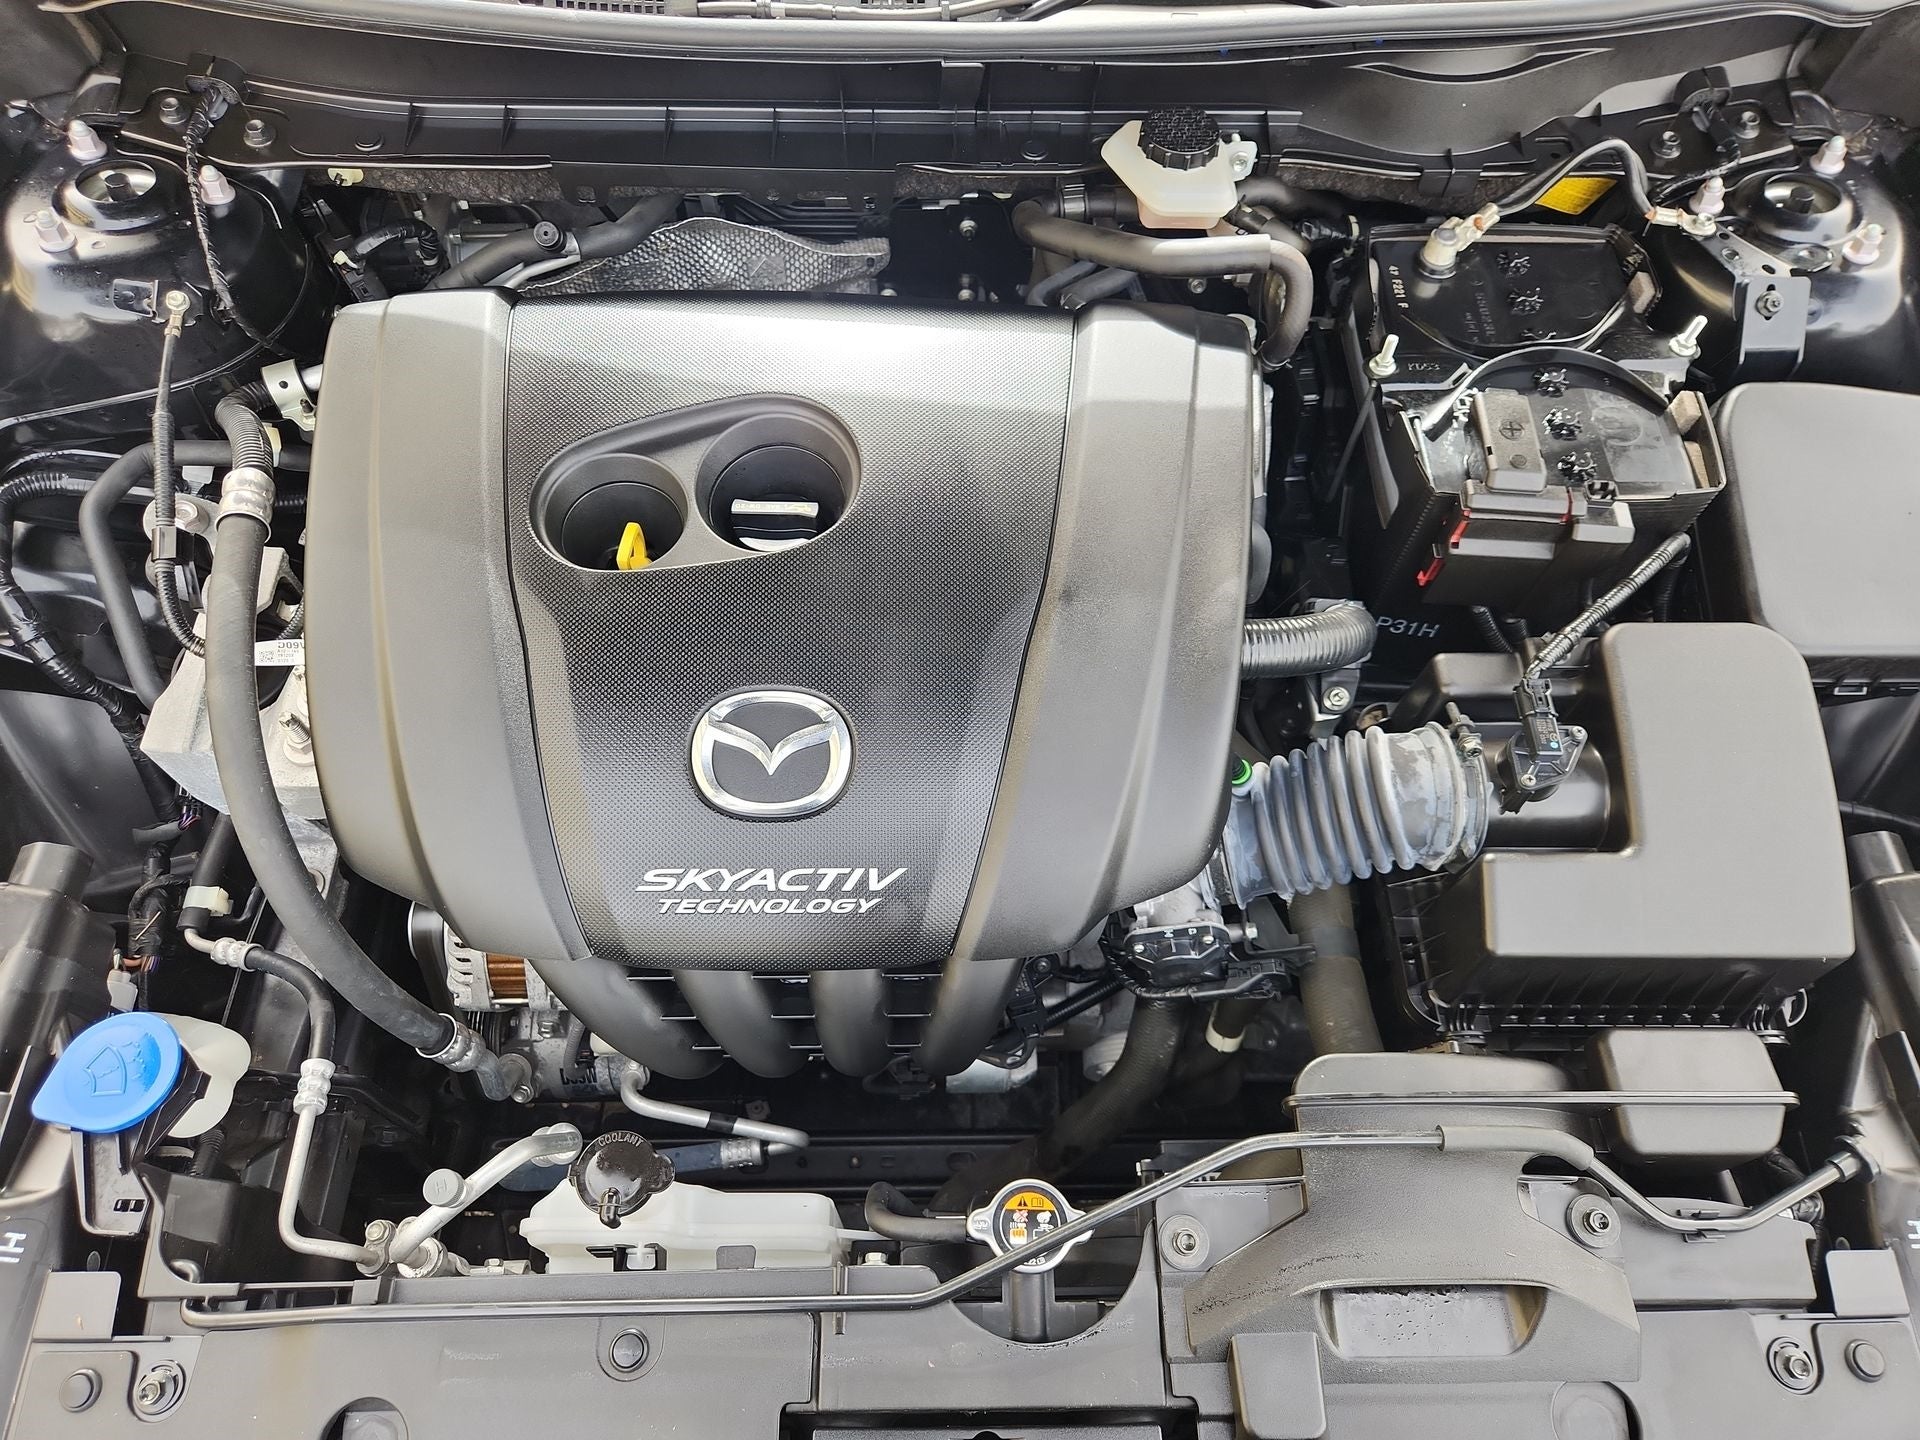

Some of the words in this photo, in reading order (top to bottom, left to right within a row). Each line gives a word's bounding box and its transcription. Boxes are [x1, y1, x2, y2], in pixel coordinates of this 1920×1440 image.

[1375, 616, 1440, 638] P31H
[635, 867, 908, 893] SKYACTIV
[658, 898, 883, 914] TECHNOLOGY
[597, 1132, 644, 1147] COOLANT
